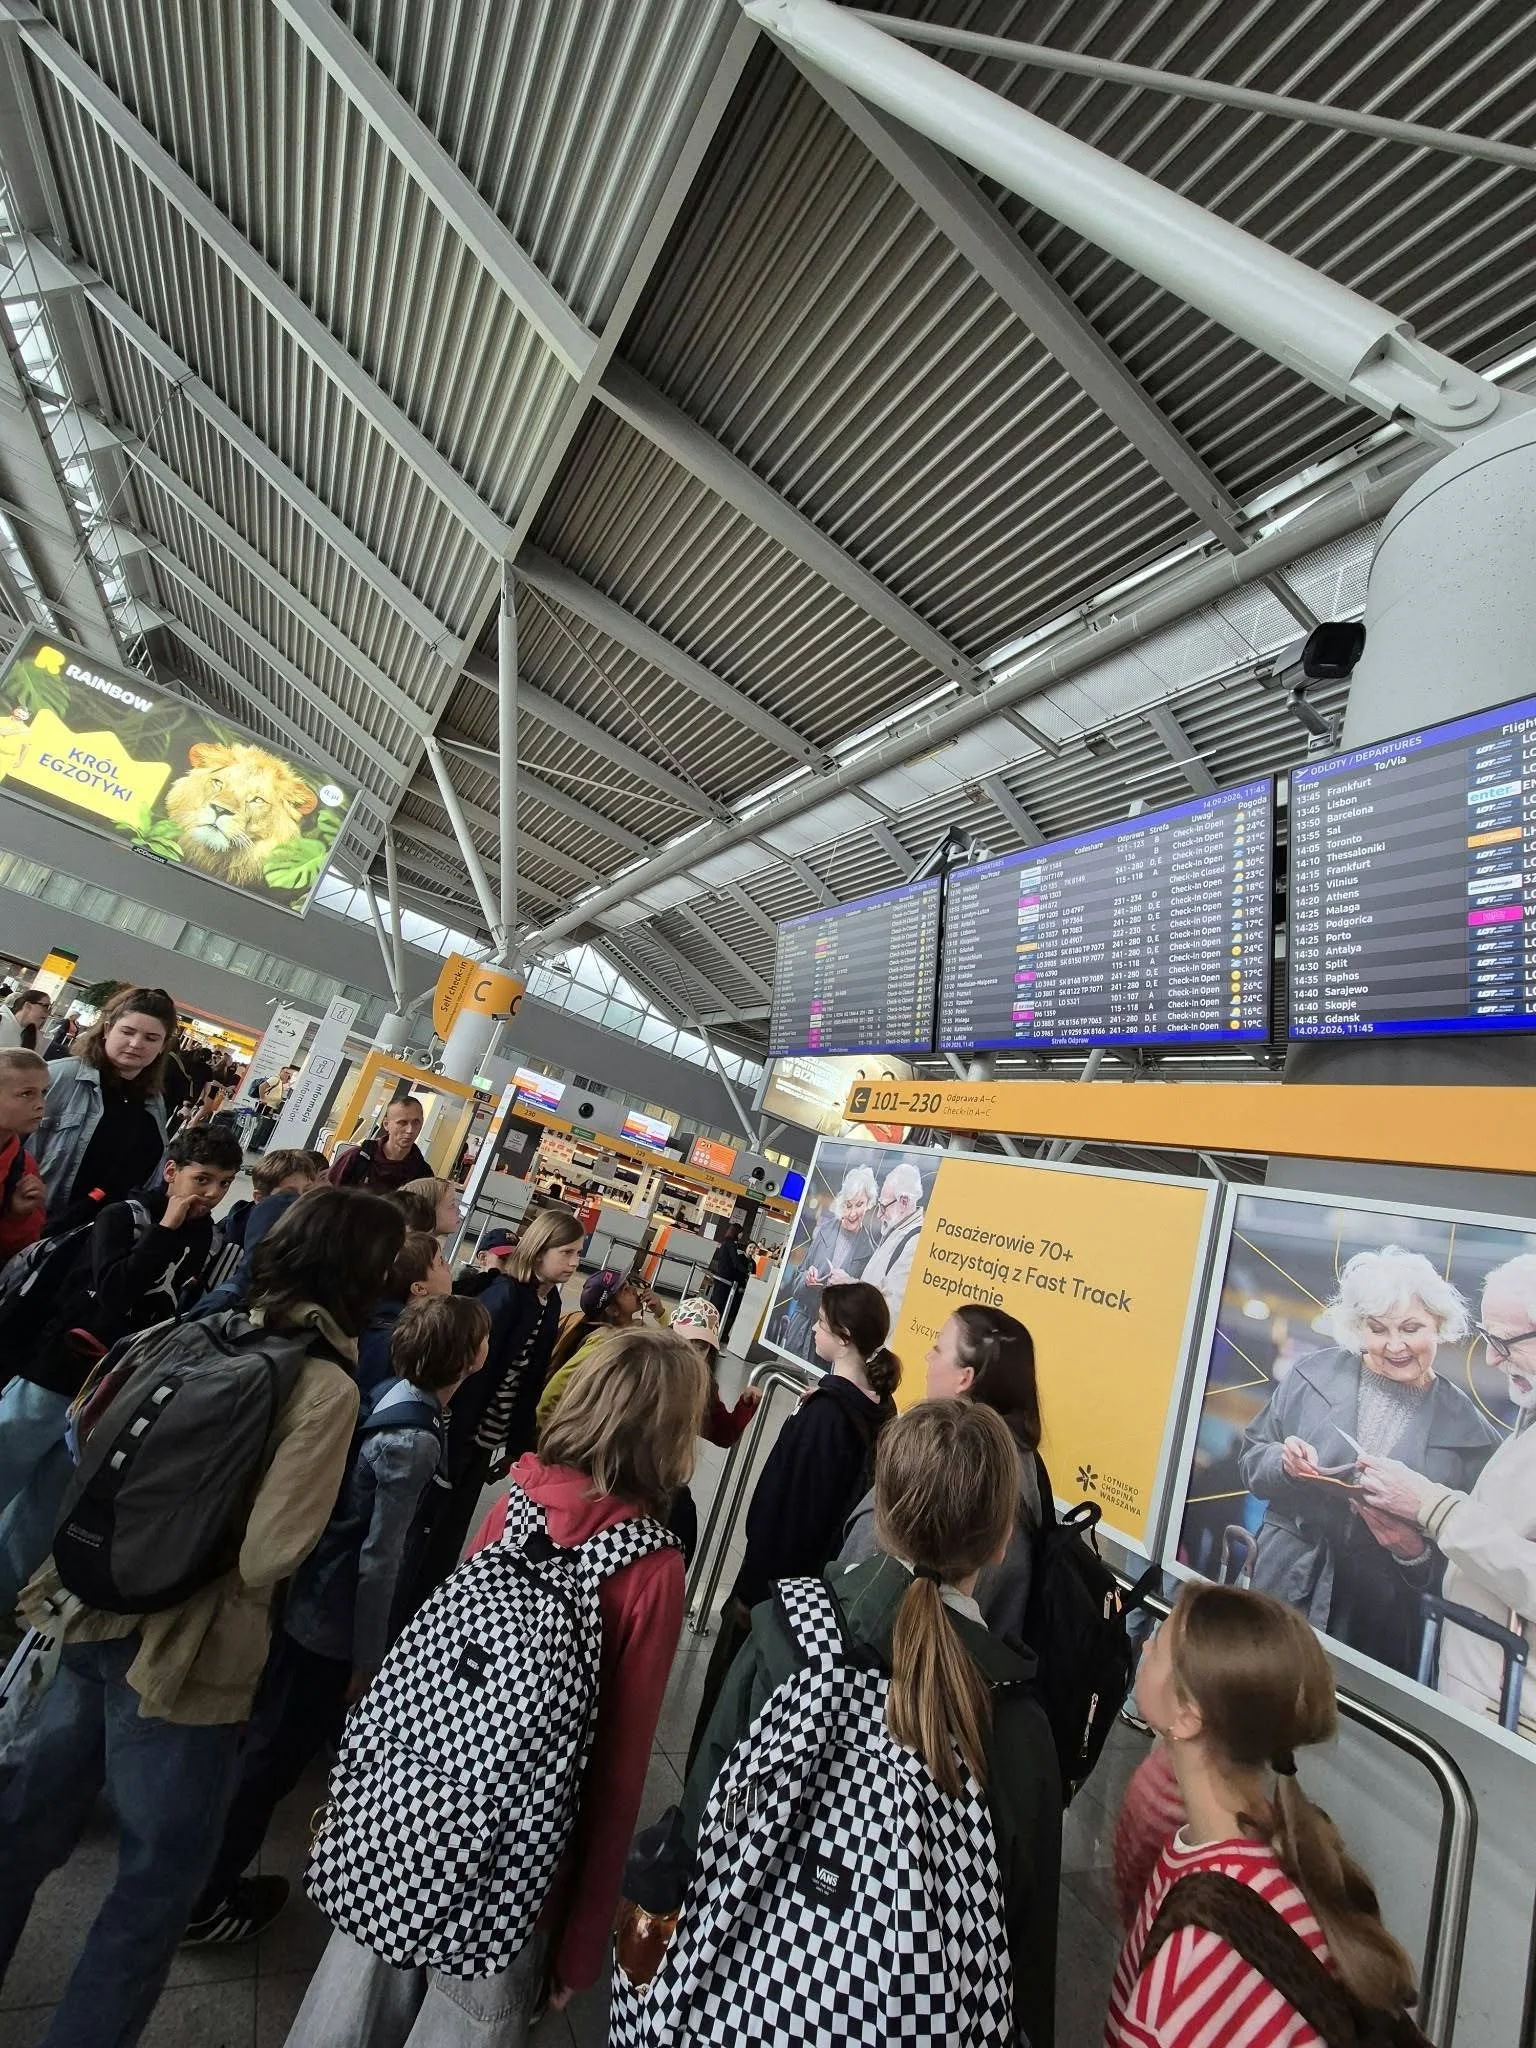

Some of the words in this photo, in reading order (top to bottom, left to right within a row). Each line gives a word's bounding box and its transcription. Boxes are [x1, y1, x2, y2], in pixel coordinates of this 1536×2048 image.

[66, 664, 153, 712] RAINBOW
[1310, 759, 1347, 776] ODLOTY
[1355, 736, 1422, 762] DEPARTURES
[68, 748, 119, 780] KRÓL
[1374, 756, 1408, 771] To/Via
[39, 753, 133, 802] EGZOTYKI
[1296, 792, 1320, 804] 13:45
[1328, 778, 1372, 796] Frankfurt
[1298, 781, 1320, 792] Time
[1470, 784, 1511, 802] enter
[1203, 792, 1243, 808] 14.09.2026,
[1245, 784, 1266, 796] 11:45
[1238, 796, 1267, 810] Pogoda
[1296, 804, 1320, 818] 13:45
[1328, 796, 1358, 810] Lisbon
[1192, 810, 1214, 822] Uwagi
[1296, 818, 1320, 830] 13:50
[1327, 806, 1374, 822] Barcelona
[1204, 819, 1224, 830] Open
[1117, 830, 1144, 843] Odprawa
[1204, 832, 1224, 842] Open
[1296, 830, 1320, 843] 13:55
[1327, 826, 1341, 836] Sal
[1204, 844, 1223, 854] Open
[1296, 844, 1320, 856] 14:05
[1327, 835, 1362, 849] Toronto
[1204, 856, 1222, 866] Open
[1296, 856, 1320, 868] 14:10
[1327, 842, 1386, 862] Thessaloniki
[1201, 864, 1224, 877] Closed
[1296, 870, 1320, 882] 14:15
[1326, 860, 1372, 876] Frankfurt
[1203, 878, 1222, 888] Open
[1296, 882, 1320, 894] 14:15
[1326, 876, 1358, 888] Vilnius
[1202, 890, 1222, 900] Open
[1296, 896, 1320, 908] 14:20
[1326, 890, 1360, 902] Athens
[1202, 902, 1222, 912] Open
[1296, 909, 1319, 920] 14:25
[1326, 904, 1360, 916] Malaga
[1202, 914, 1222, 924] Open
[1296, 922, 1319, 933] 14:25
[1326, 915, 1373, 928] Podgorica
[1202, 926, 1221, 935] Open
[1202, 938, 1221, 948] Open
[1295, 936, 1319, 946] 14:25
[1326, 932, 1352, 942] Porto
[1201, 950, 1220, 960] Open
[1295, 948, 1319, 959] 14:30
[1326, 944, 1362, 956] Antalya
[1201, 962, 1220, 972] Open
[1294, 962, 1319, 972] 14:30
[1326, 958, 1348, 970] Split
[1200, 974, 1220, 984] Open
[1294, 975, 1318, 986] 14:35
[1326, 972, 1360, 984] Paphos
[440, 996, 451, 1012] Self
[450, 961, 468, 996] check-in
[474, 980, 492, 1002] C
[1200, 986, 1220, 995] Open
[1294, 988, 1318, 998] 14:40
[1325, 986, 1368, 996] Sarajewo
[510, 995, 522, 1016] C
[1200, 998, 1220, 1007] Open
[1294, 1002, 1318, 1012] 14:40
[1325, 1000, 1357, 1010] Skopje
[1200, 1010, 1220, 1019] Open
[1294, 1015, 1318, 1025] 14:45
[1325, 1012, 1360, 1024] Gdansk
[1200, 1022, 1219, 1032] Open
[1294, 1026, 1345, 1036] 14.09.2026,
[1348, 1024, 1374, 1033] 11:45
[946, 1094, 978, 1102] Odprawa
[524, 1110, 536, 1118] 230
[944, 1106, 974, 1116] Check-in
[936, 1218, 1036, 1255] Pasażerowie
[1040, 1239, 1074, 1262] 70+
[929, 1242, 1010, 1284] korzystają
[1012, 1266, 1022, 1282] z
[1025, 1266, 1067, 1294] Fast
[1072, 1278, 1132, 1313] Track
[922, 1268, 1004, 1308] bezpłatnie
[1103, 1474, 1138, 1496] LOTNISKO
[1102, 1482, 1134, 1503] CHOPINA
[1100, 1490, 1140, 1516] WARSZAWA
[816, 1864, 840, 1886] VANS
